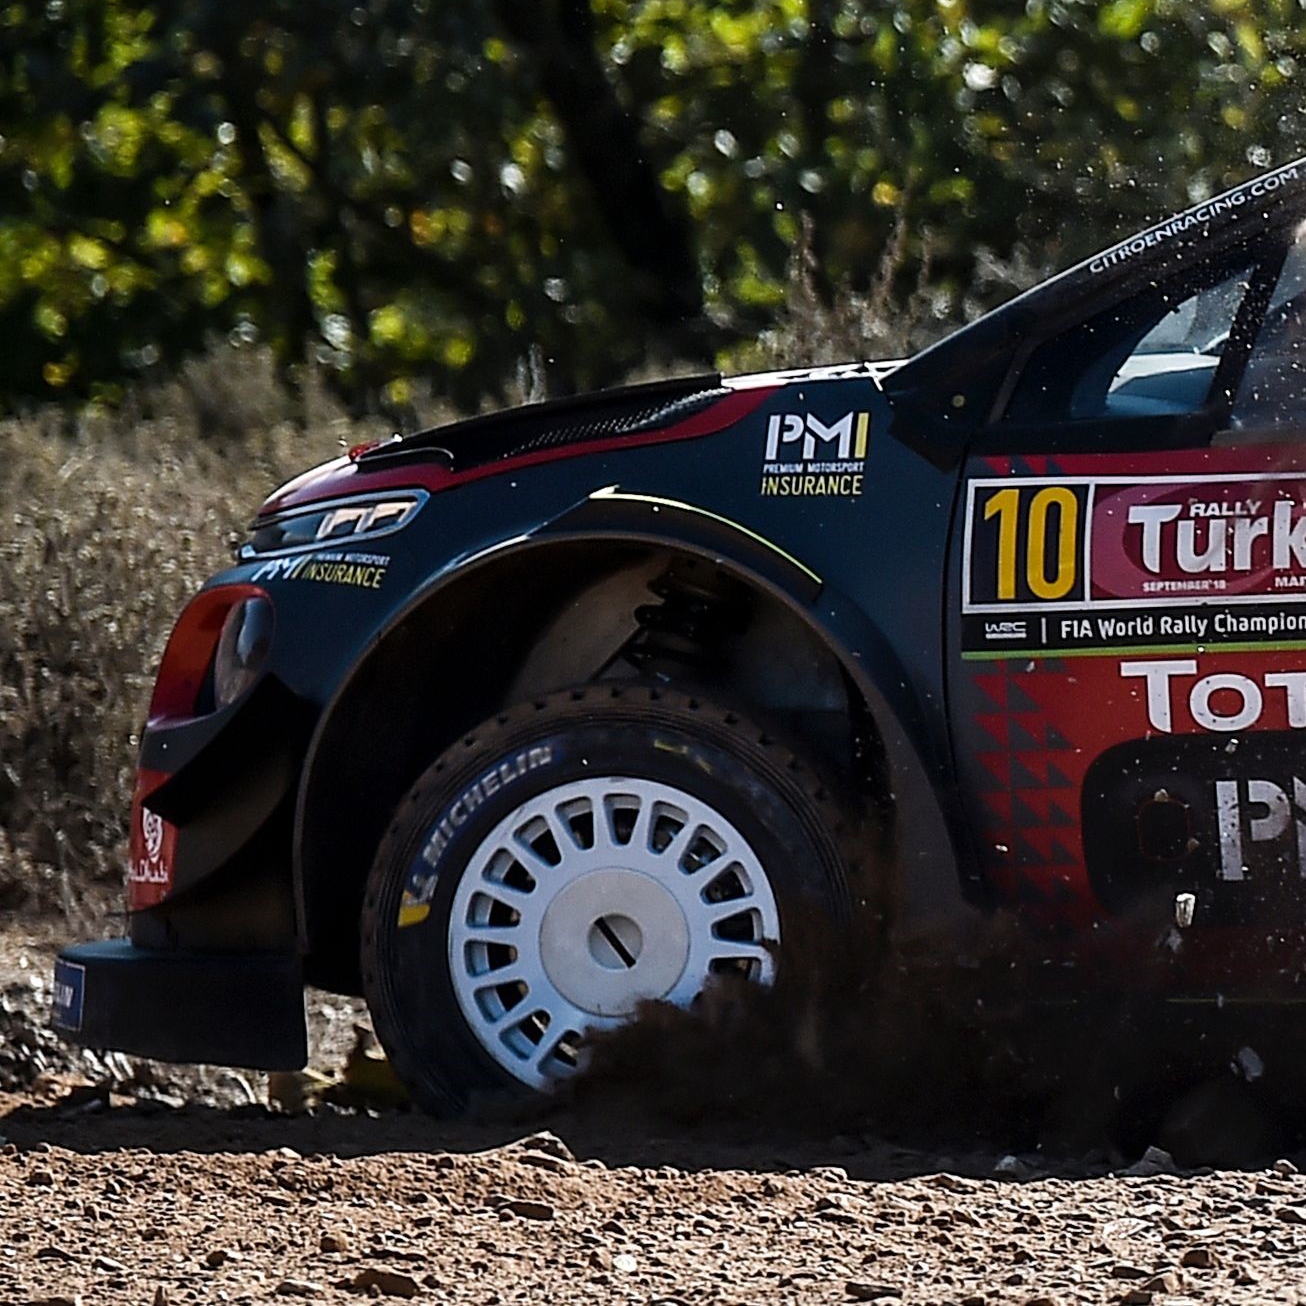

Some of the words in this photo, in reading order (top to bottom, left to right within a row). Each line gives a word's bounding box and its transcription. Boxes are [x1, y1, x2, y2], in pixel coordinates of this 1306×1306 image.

[1088, 167, 1300, 274] CITROENRACING.COM
[764, 411, 870, 461] PMI
[807, 461, 865, 473] MOTORSPORT
[760, 475, 865, 496] INSURANCE
[1189, 500, 1263, 518] RALLY
[984, 486, 1079, 600] 10
[300, 562, 387, 590] INSURANCE
[1061, 620, 1094, 639] FIA
[1097, 616, 1154, 639] World
[1159, 614, 1208, 637] Rally
[423, 746, 553, 868] MICHELIN
